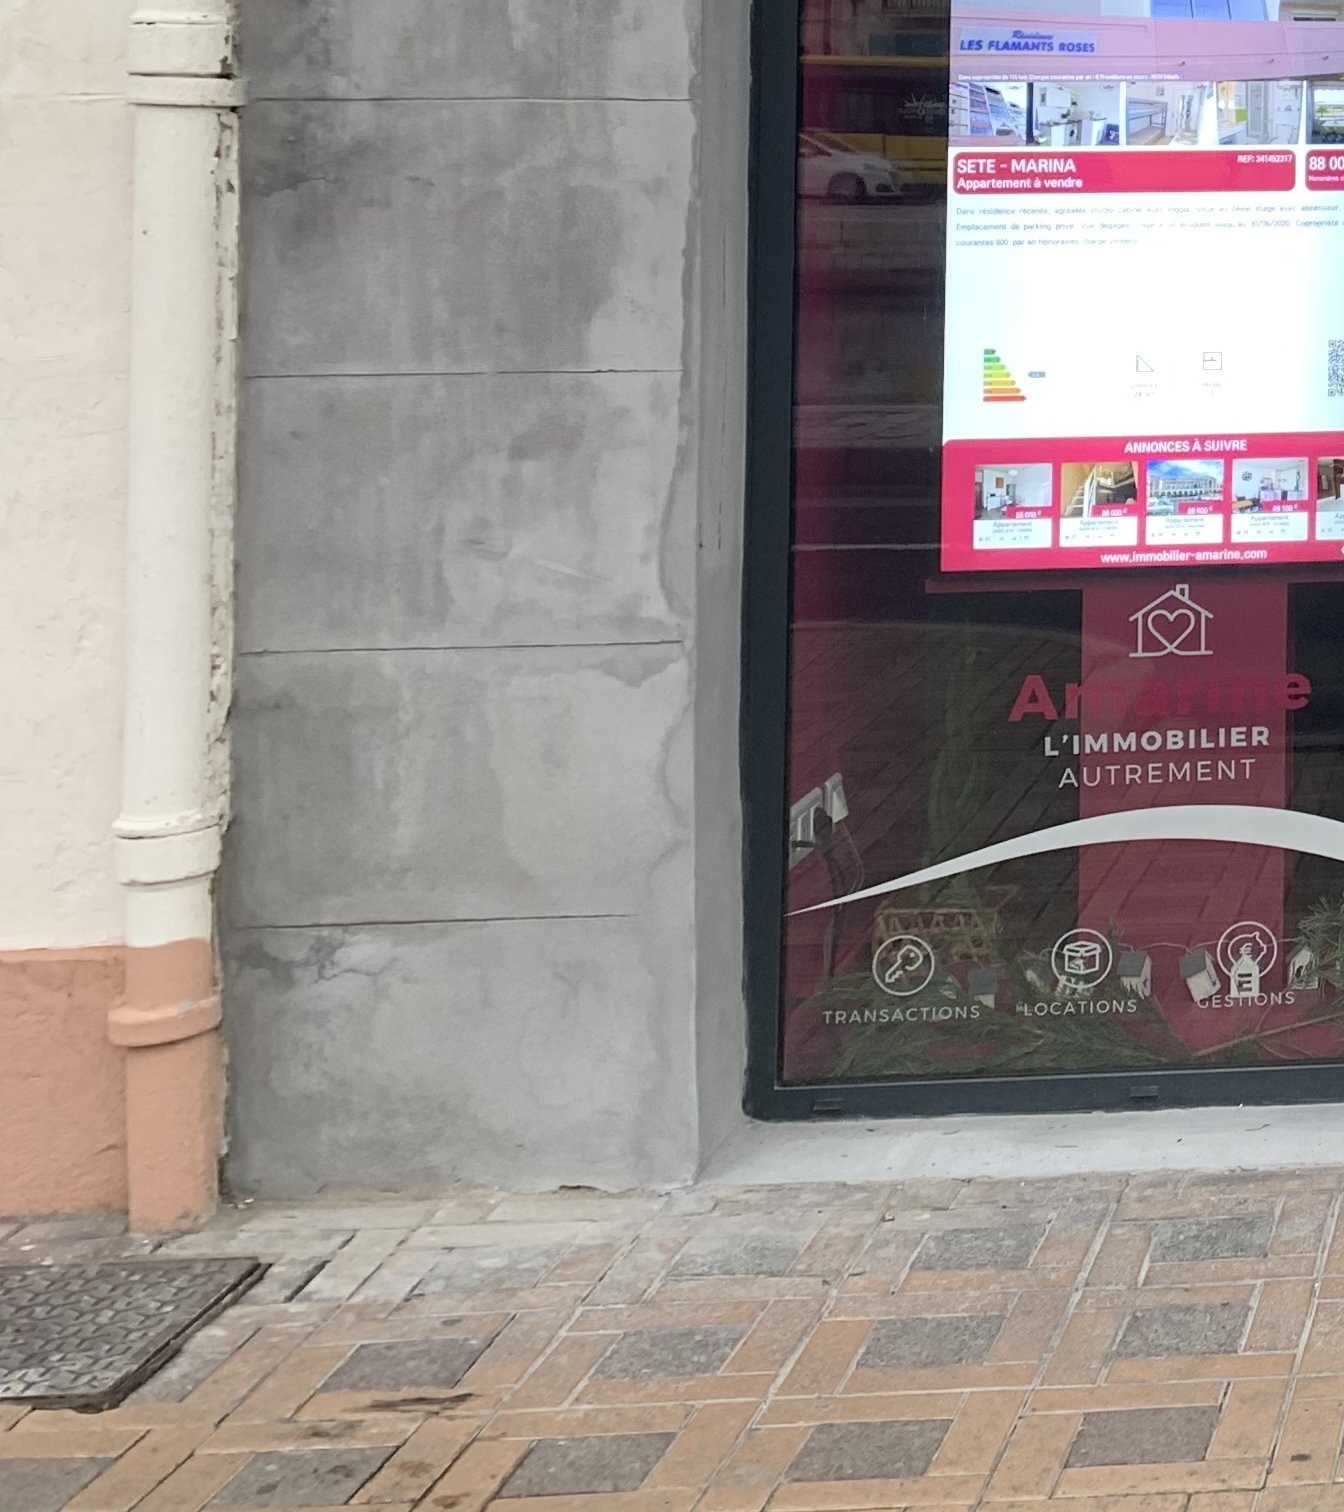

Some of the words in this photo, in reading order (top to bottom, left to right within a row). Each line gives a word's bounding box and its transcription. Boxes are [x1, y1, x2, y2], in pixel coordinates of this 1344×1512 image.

[959, 39, 983, 51] LES
[987, 39, 1054, 52] FLAMANTS
[1058, 42, 1096, 53] ROSES
[957, 158, 996, 174] SETE
[1011, 158, 1076, 174] MARINA
[1309, 156, 1326, 171] 88
[957, 177, 1031, 190] Appartement
[1034, 177, 1041, 188] à
[1044, 177, 1083, 188] vendre
[1124, 440, 1190, 454] ANNONCES
[1192, 438, 1202, 452] À
[1204, 439, 1248, 452] SUIVRE
[1100, 548, 1268, 564] www.immobilier-amarine.com
[1008, 671, 1312, 722] Amarine
[1044, 726, 1270, 757] L'IMMOBILIER
[1058, 758, 1256, 788] AUTREMENT
[822, 1004, 981, 1025] TRANSACTIONS
[1024, 999, 1138, 1016] LOCATIONS
